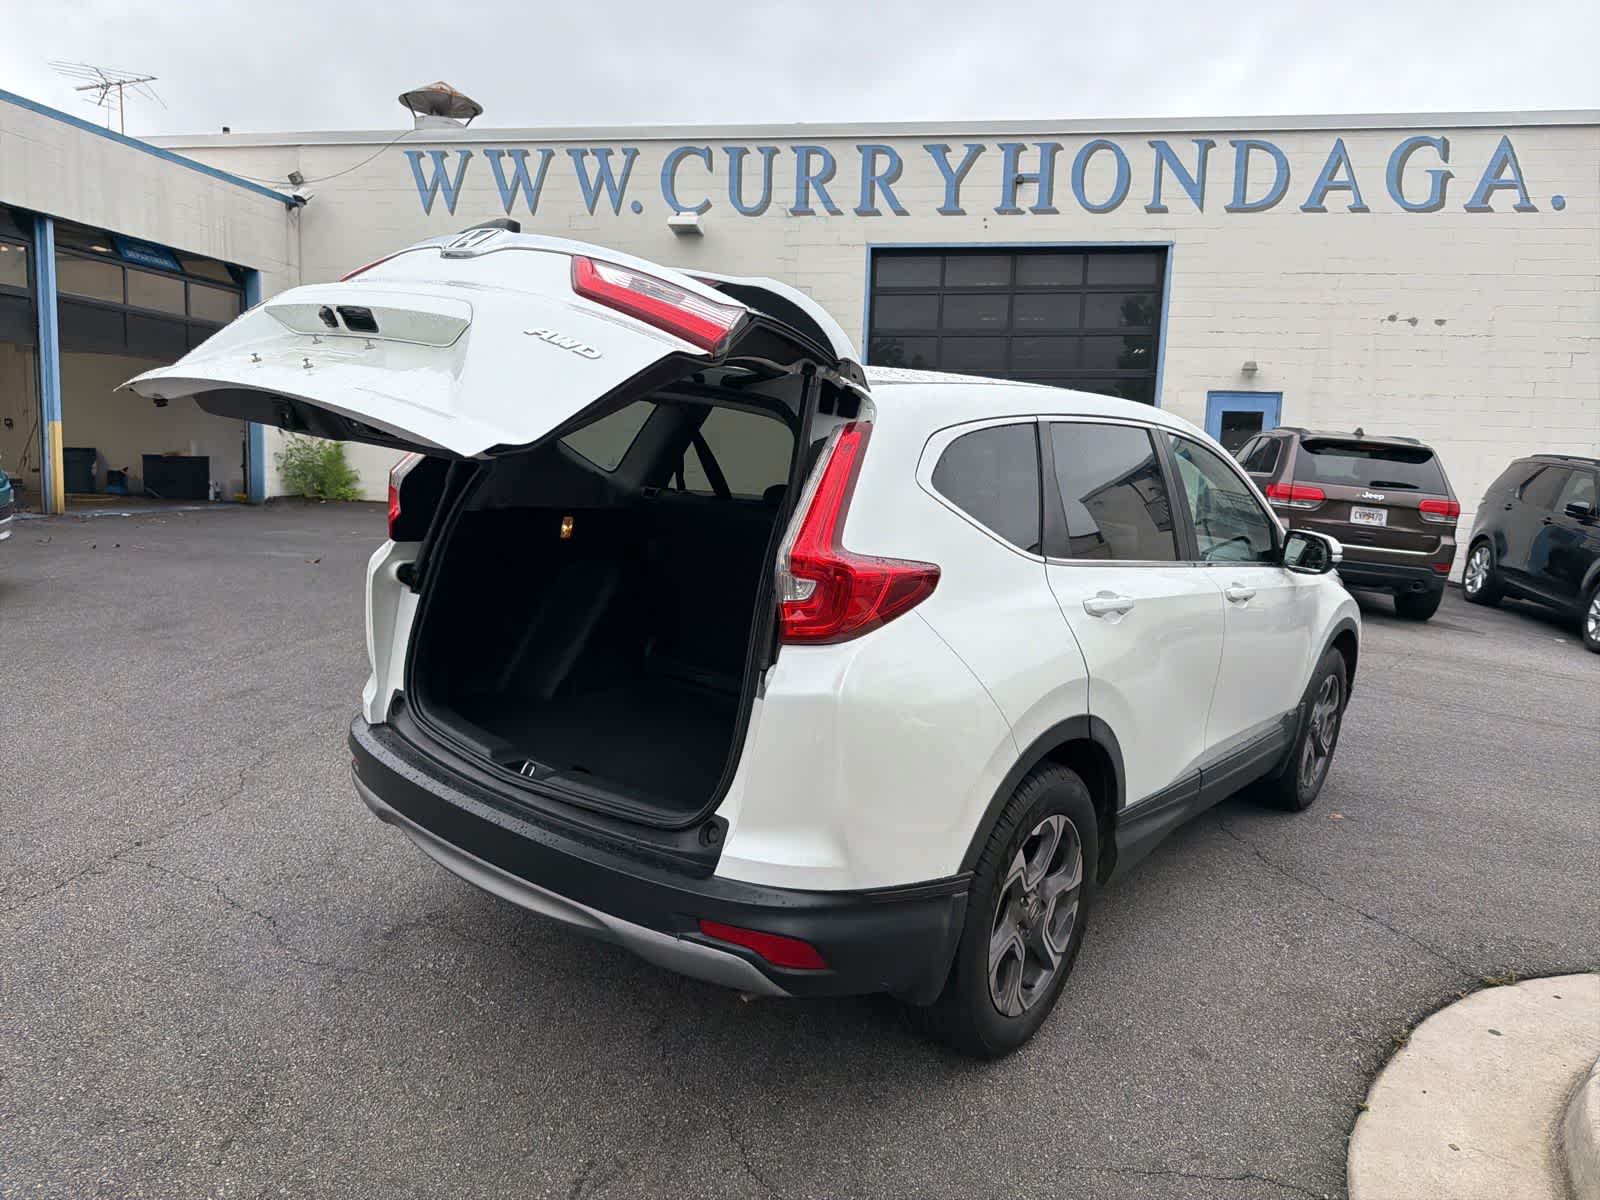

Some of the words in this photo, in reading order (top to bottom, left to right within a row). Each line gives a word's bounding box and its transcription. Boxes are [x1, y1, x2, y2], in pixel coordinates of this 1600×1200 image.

[403, 135, 1566, 217] WWW.CURRYHONDAGA.
[523, 328, 603, 360] AWD
[1361, 491, 1385, 501] Jeep
